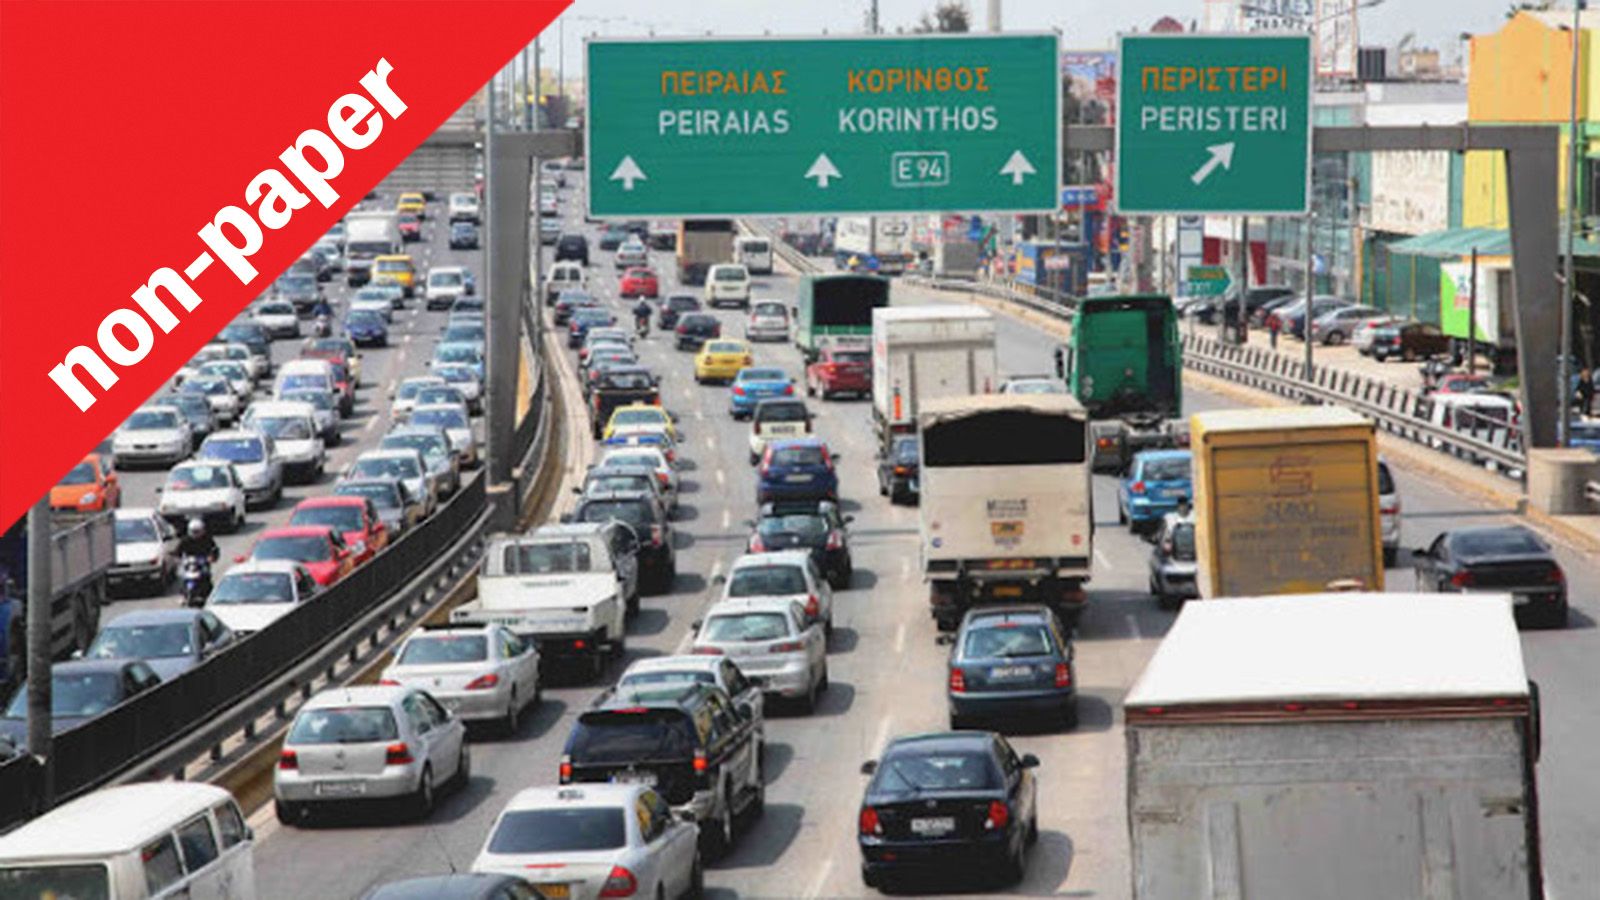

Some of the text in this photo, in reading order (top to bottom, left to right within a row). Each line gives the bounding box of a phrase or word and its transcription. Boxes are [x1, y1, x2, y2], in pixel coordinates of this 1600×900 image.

[661, 69, 788, 96] ΠΕΙΡΑΙΑΣ
[847, 66, 990, 93] ΚΟΡΙΝΘΟΣ
[1141, 65, 1288, 93] ΠΕΡΙΣΤΕΡΙ
[658, 108, 790, 136] PEIRAIAS
[838, 105, 998, 133] KORINTHOS
[1141, 105, 1287, 132] PERISTERI
[898, 157, 942, 180] E 94
